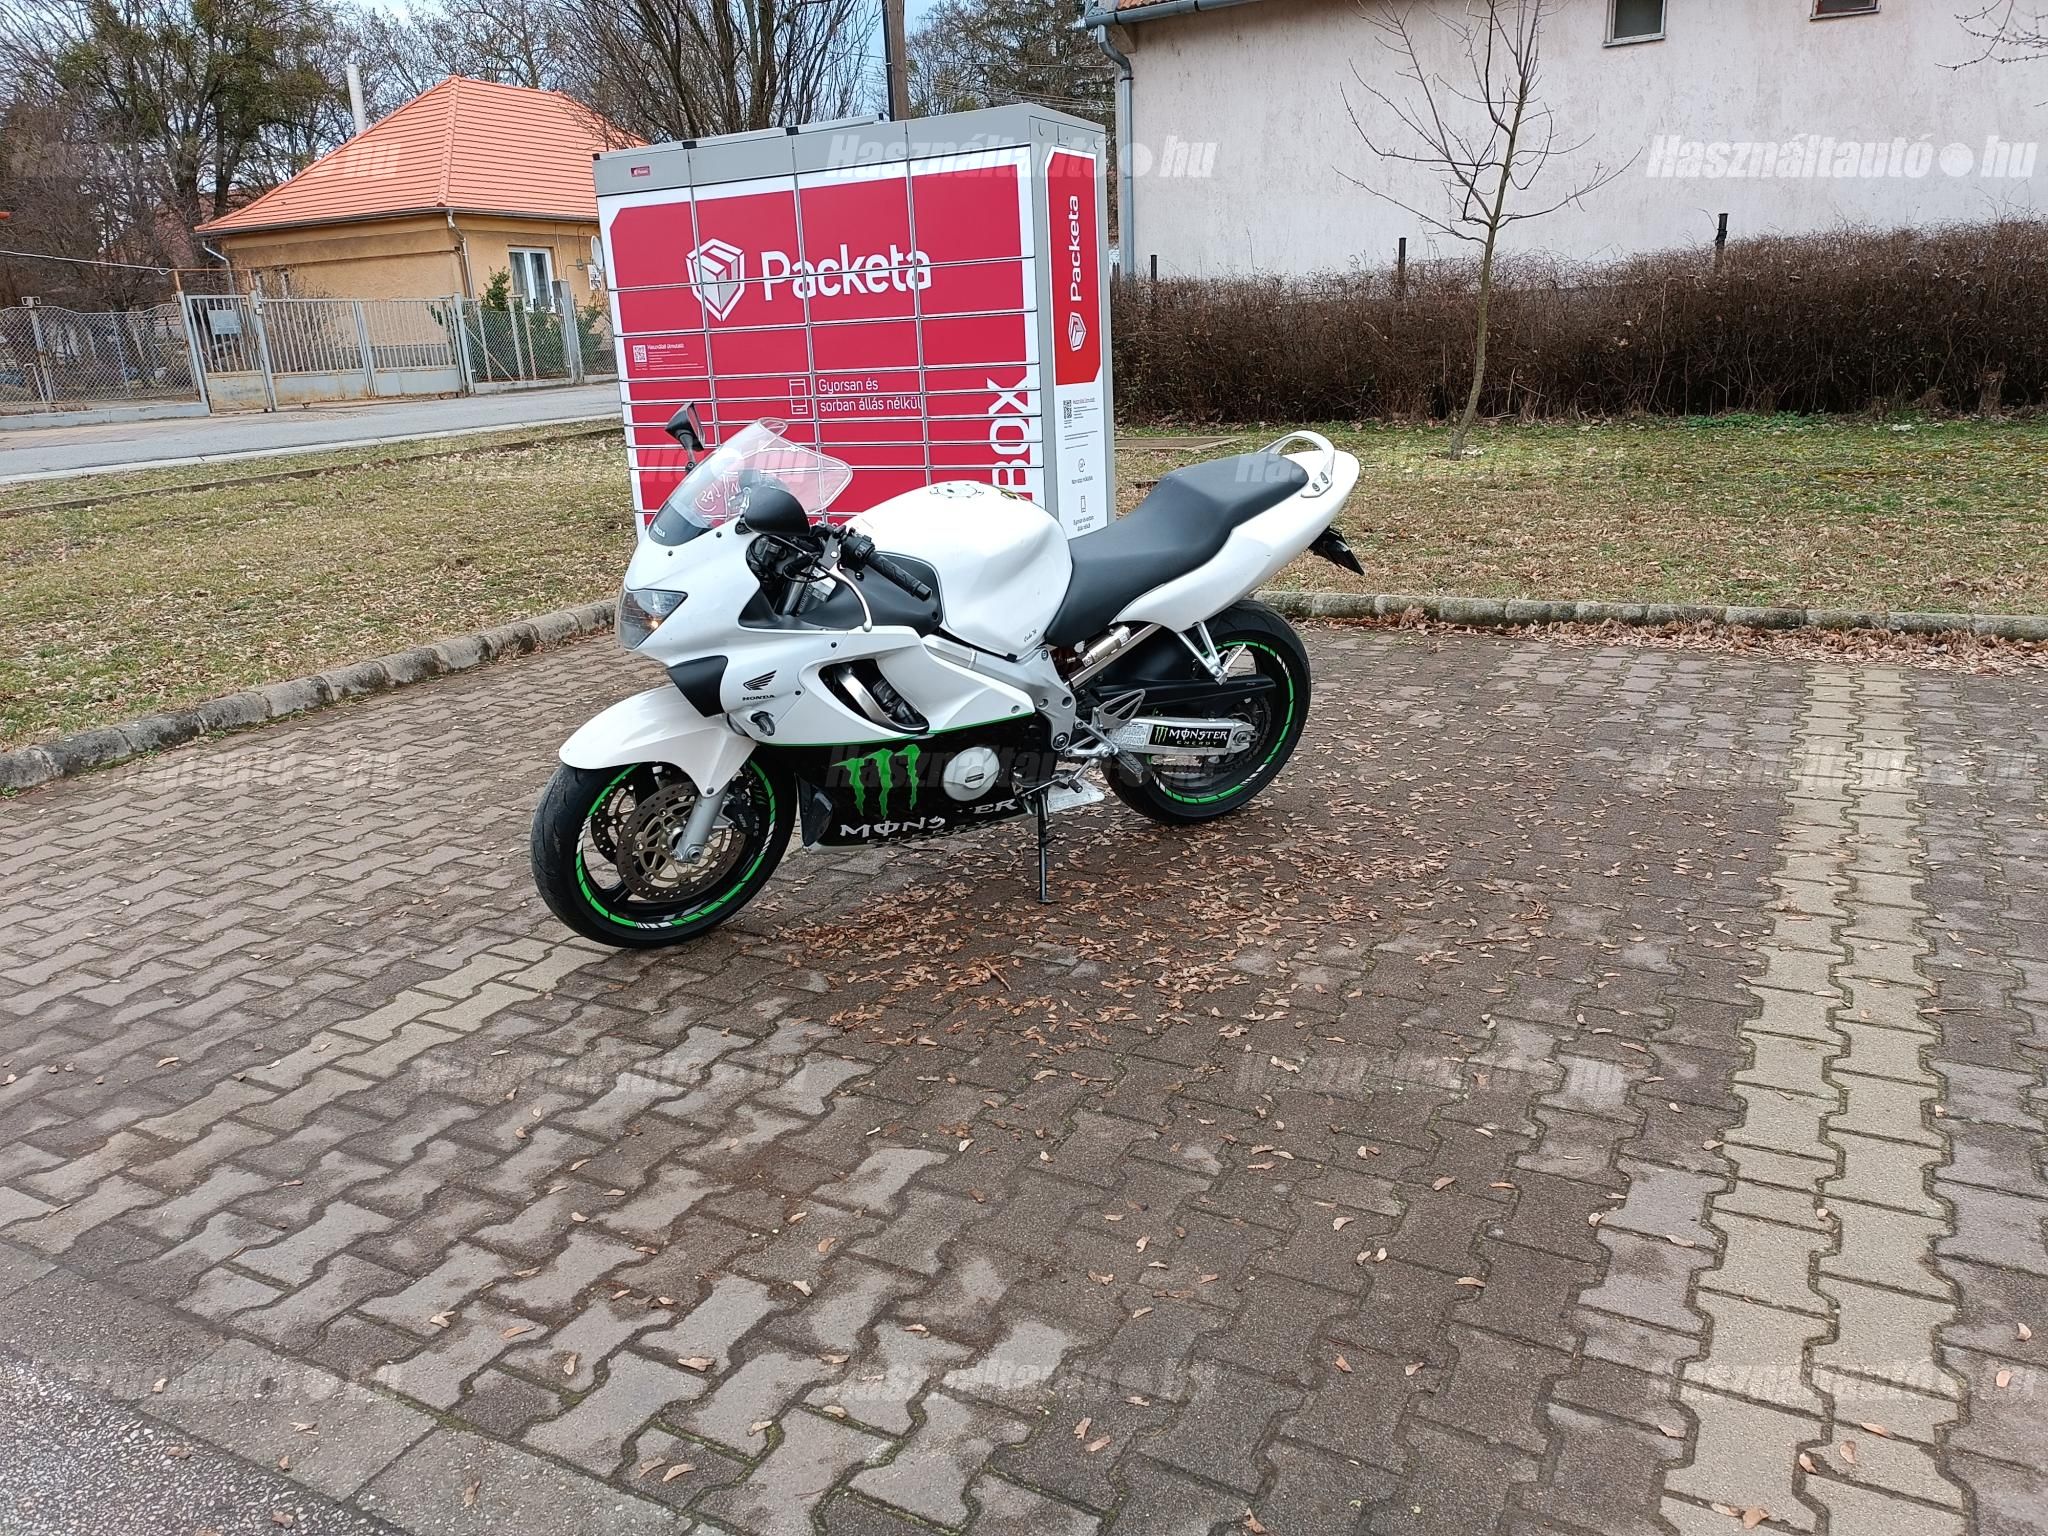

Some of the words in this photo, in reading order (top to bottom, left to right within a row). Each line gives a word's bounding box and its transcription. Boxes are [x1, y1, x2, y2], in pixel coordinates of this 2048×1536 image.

[1068, 194, 1082, 302] Packeta
[760, 243, 932, 302] Packeta
[818, 379, 863, 394] Gyorsan
[866, 378, 879, 390] és
[820, 398, 856, 412] sorban
[858, 397, 884, 411] állás
[886, 396, 922, 410] nélkül
[701, 490, 714, 503] 24
